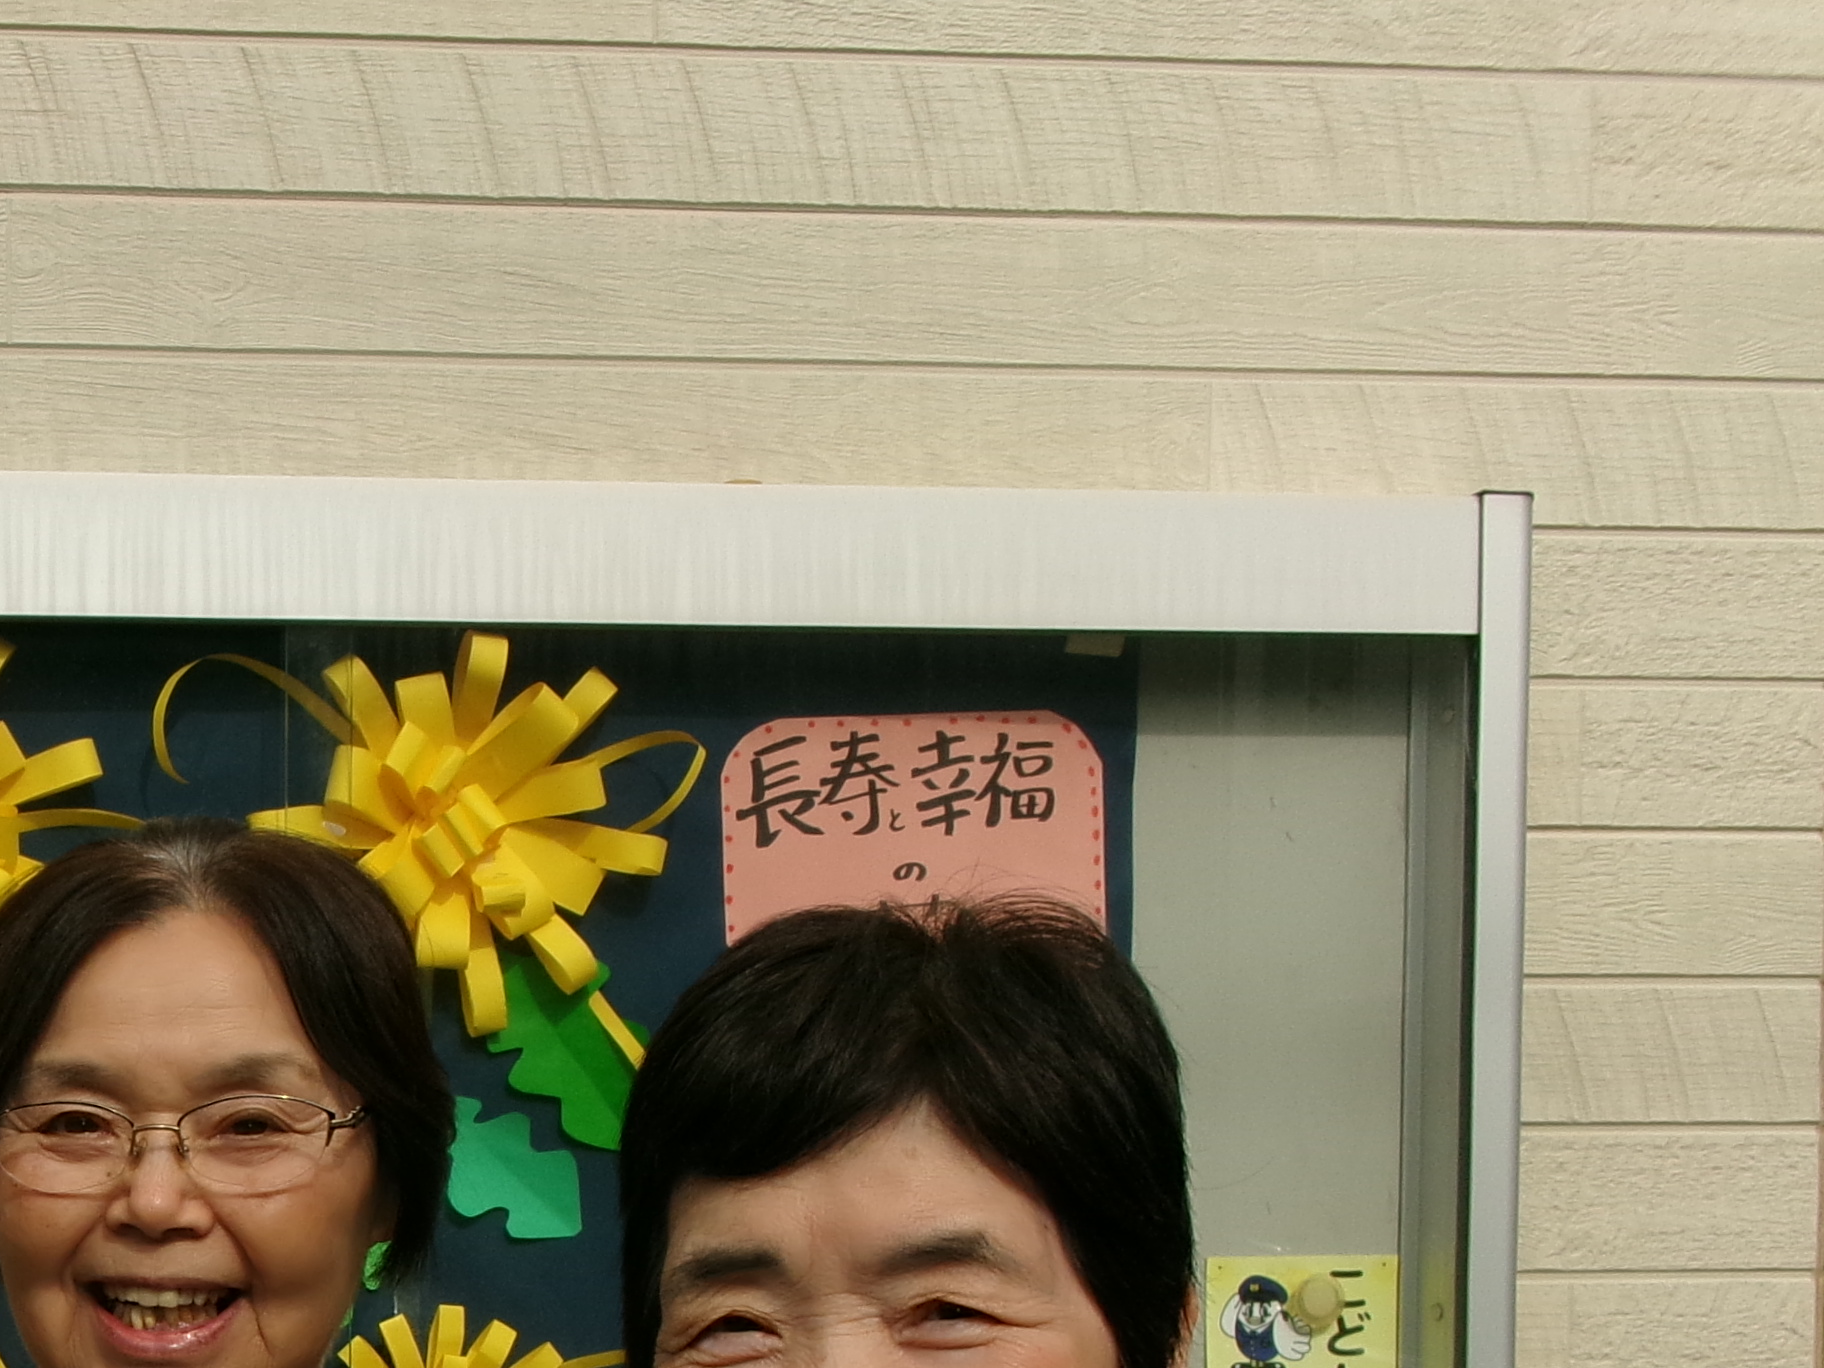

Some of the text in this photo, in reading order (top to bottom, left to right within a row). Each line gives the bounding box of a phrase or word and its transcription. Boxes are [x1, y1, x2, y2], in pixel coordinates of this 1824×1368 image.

[736, 730, 1056, 849] 長寿と幸福
[893, 861, 927, 883] の
